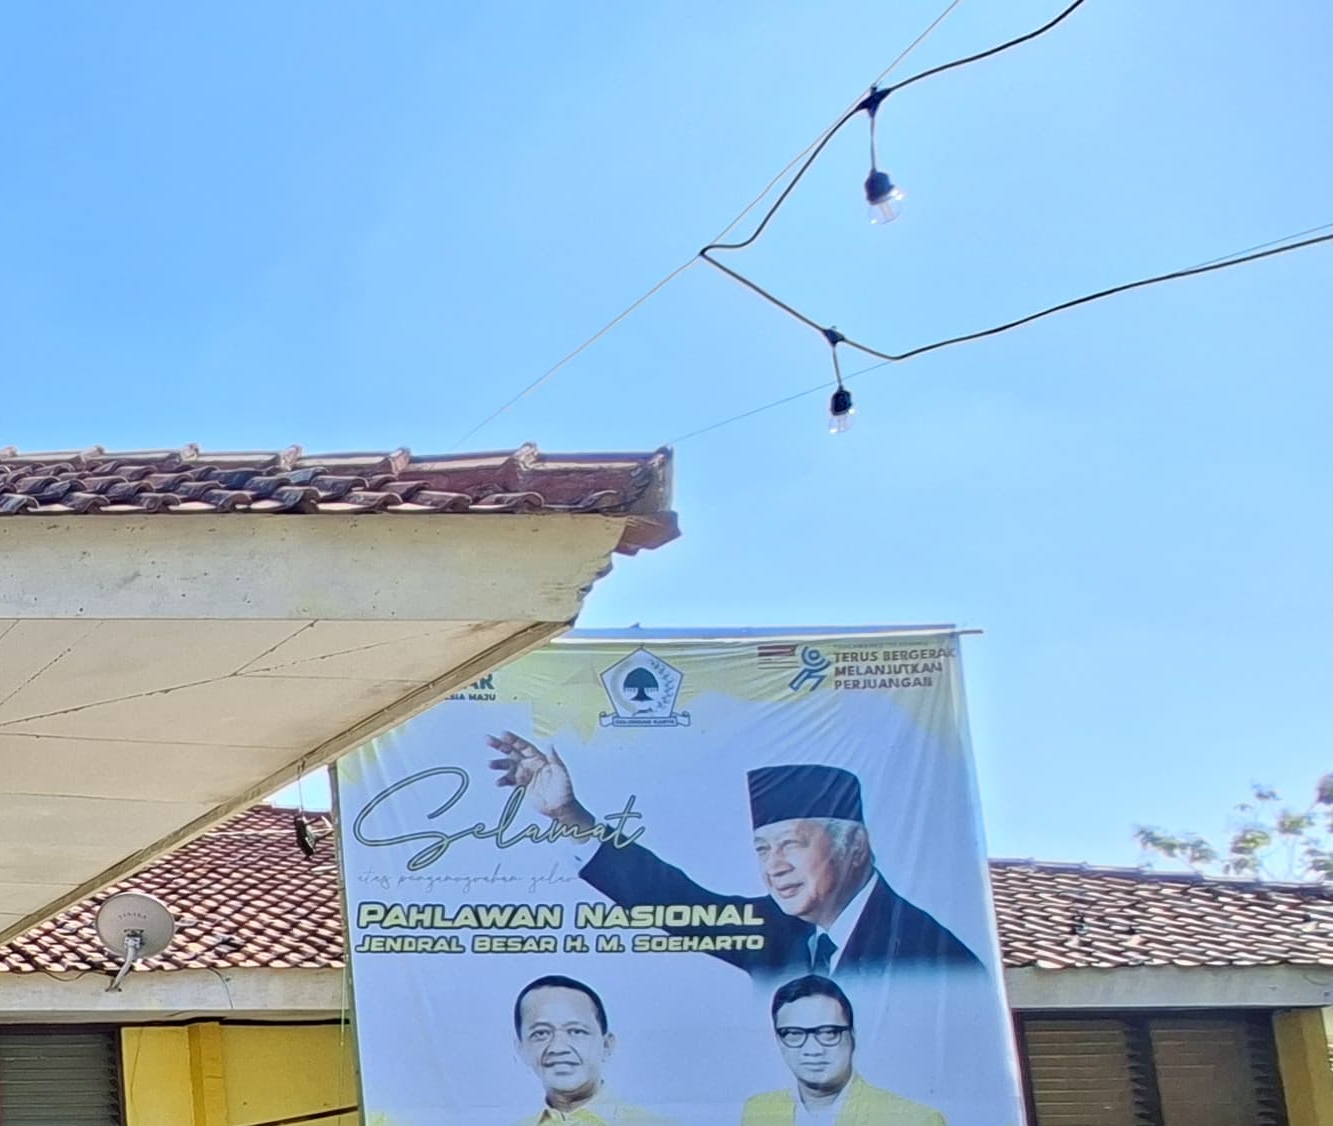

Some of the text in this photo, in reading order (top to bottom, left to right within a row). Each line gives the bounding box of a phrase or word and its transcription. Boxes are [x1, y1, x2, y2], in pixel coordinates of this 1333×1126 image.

[834, 647, 957, 663] TERUS BERGERAK
[834, 662, 942, 677] MELANJUTKAN
[834, 676, 933, 690] PERJUANGAN
[353, 766, 645, 871] Selamat
[357, 902, 766, 929] PAHLAWAN NASIONAL
[355, 933, 765, 954] JENDRAL BESAR H. M. SOEHARTO
